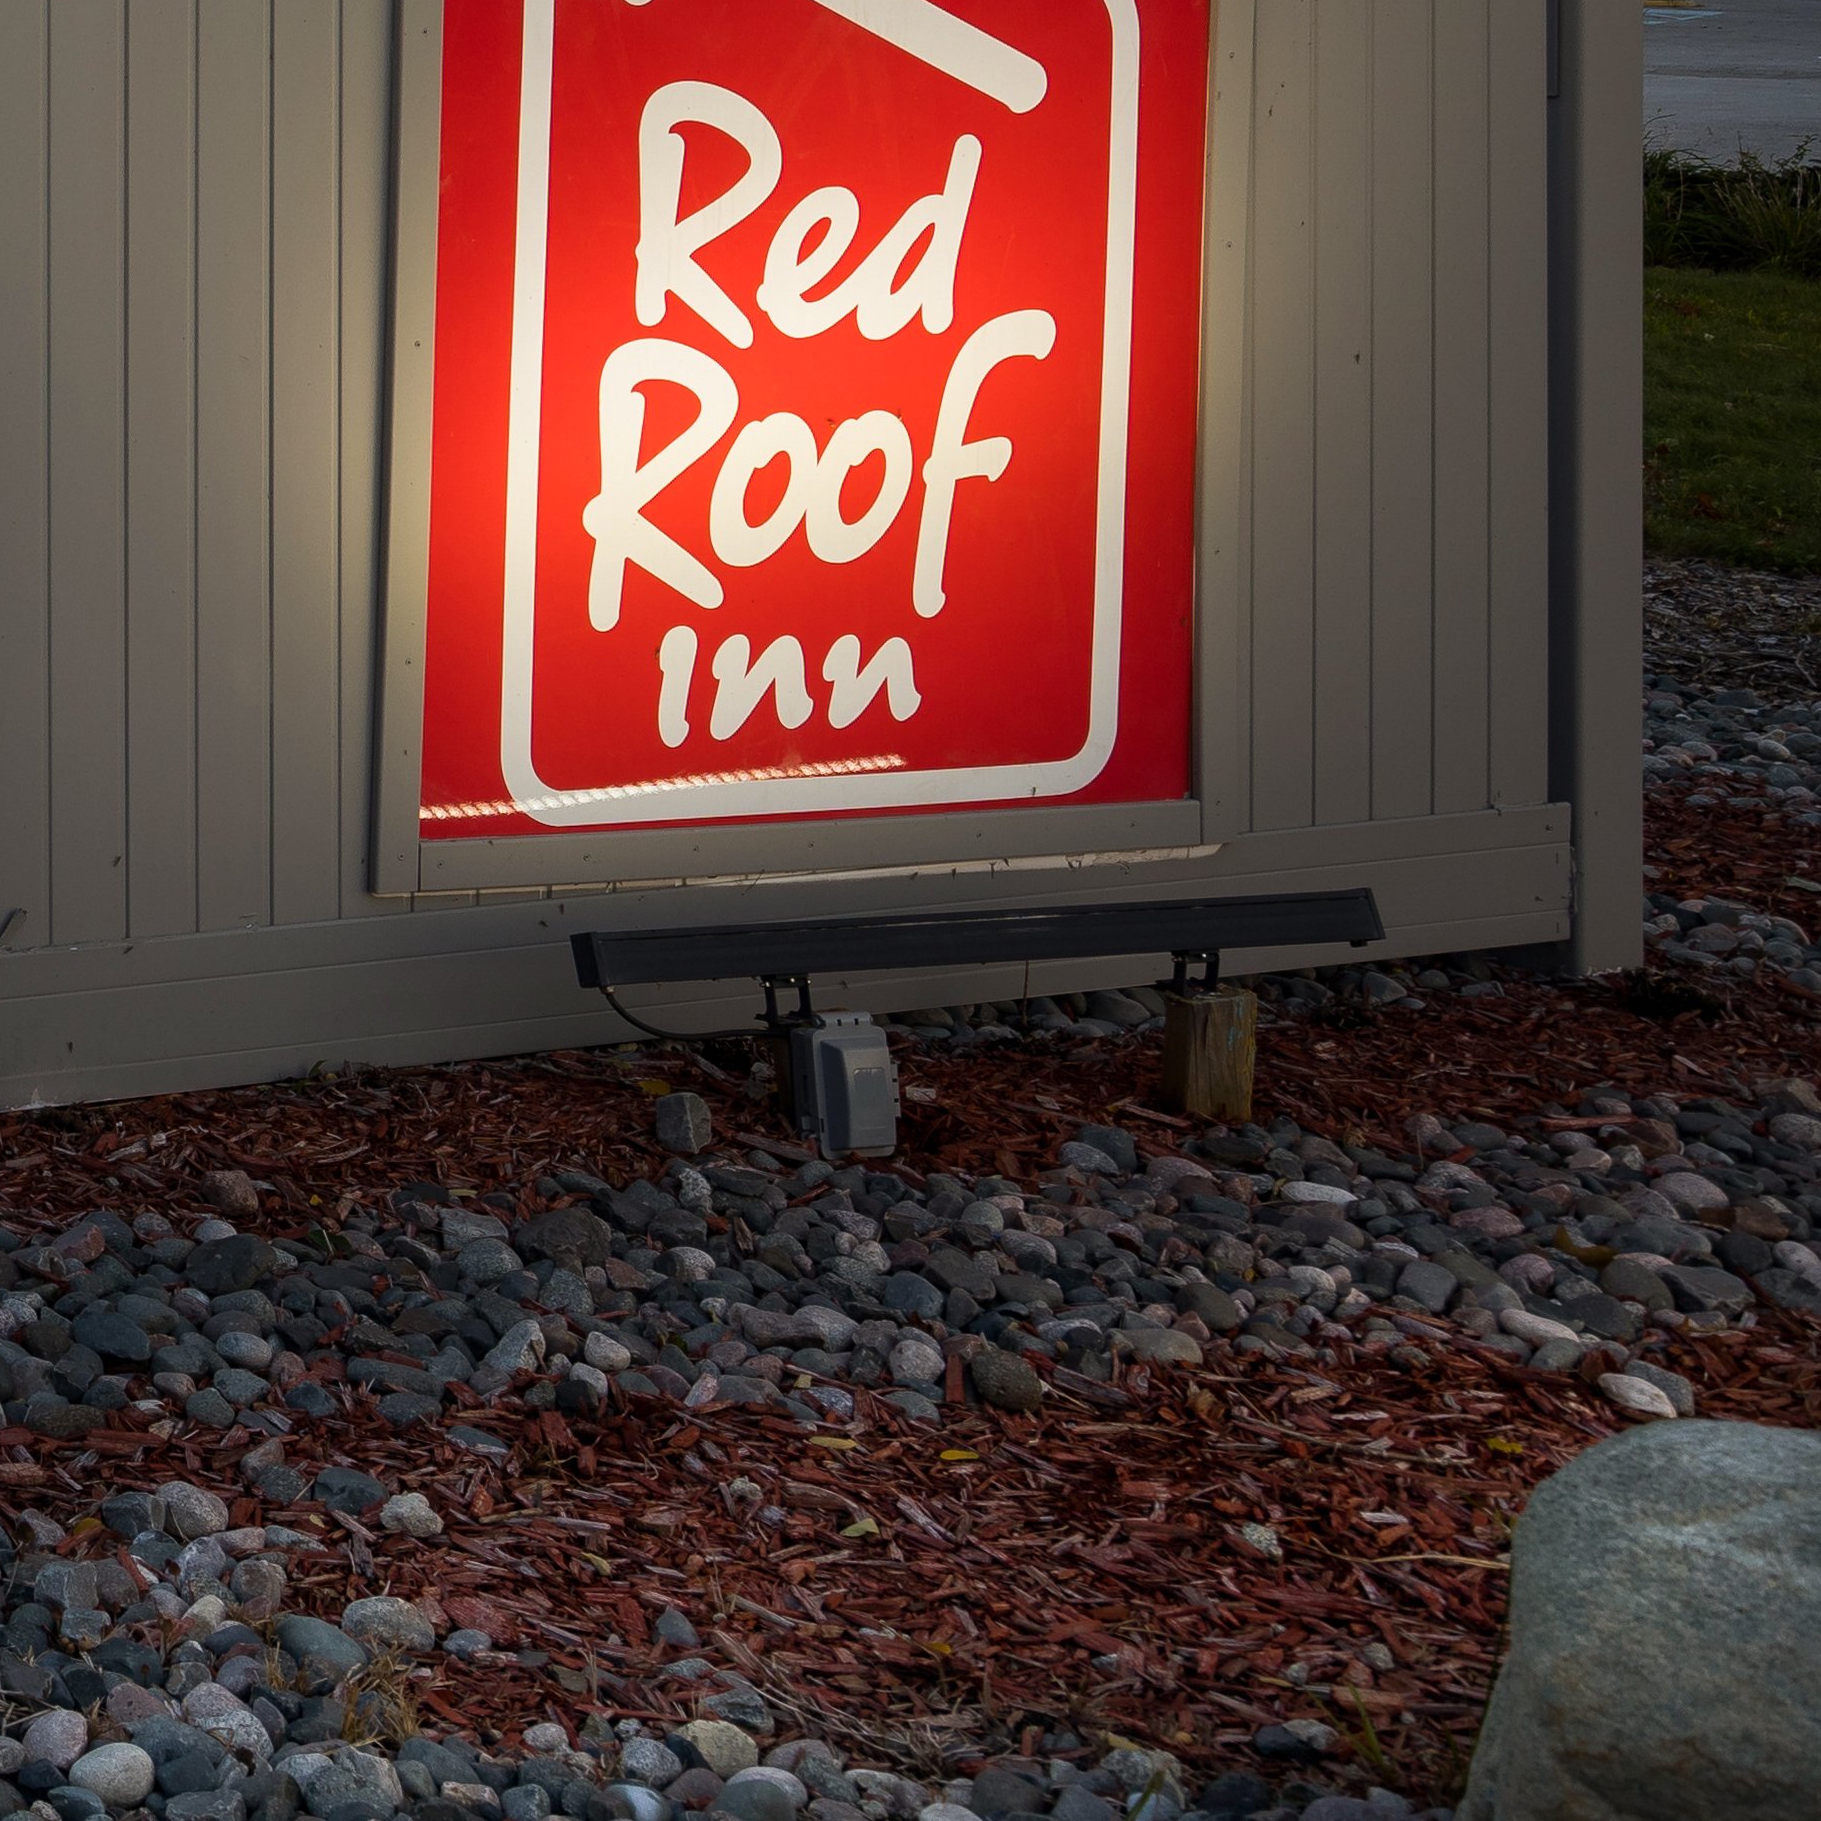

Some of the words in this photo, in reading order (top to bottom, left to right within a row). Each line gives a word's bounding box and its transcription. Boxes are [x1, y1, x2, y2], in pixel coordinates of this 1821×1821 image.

[633, 79, 982, 349] Red
[581, 308, 1057, 633] Roof
[657, 624, 922, 748] Inn
